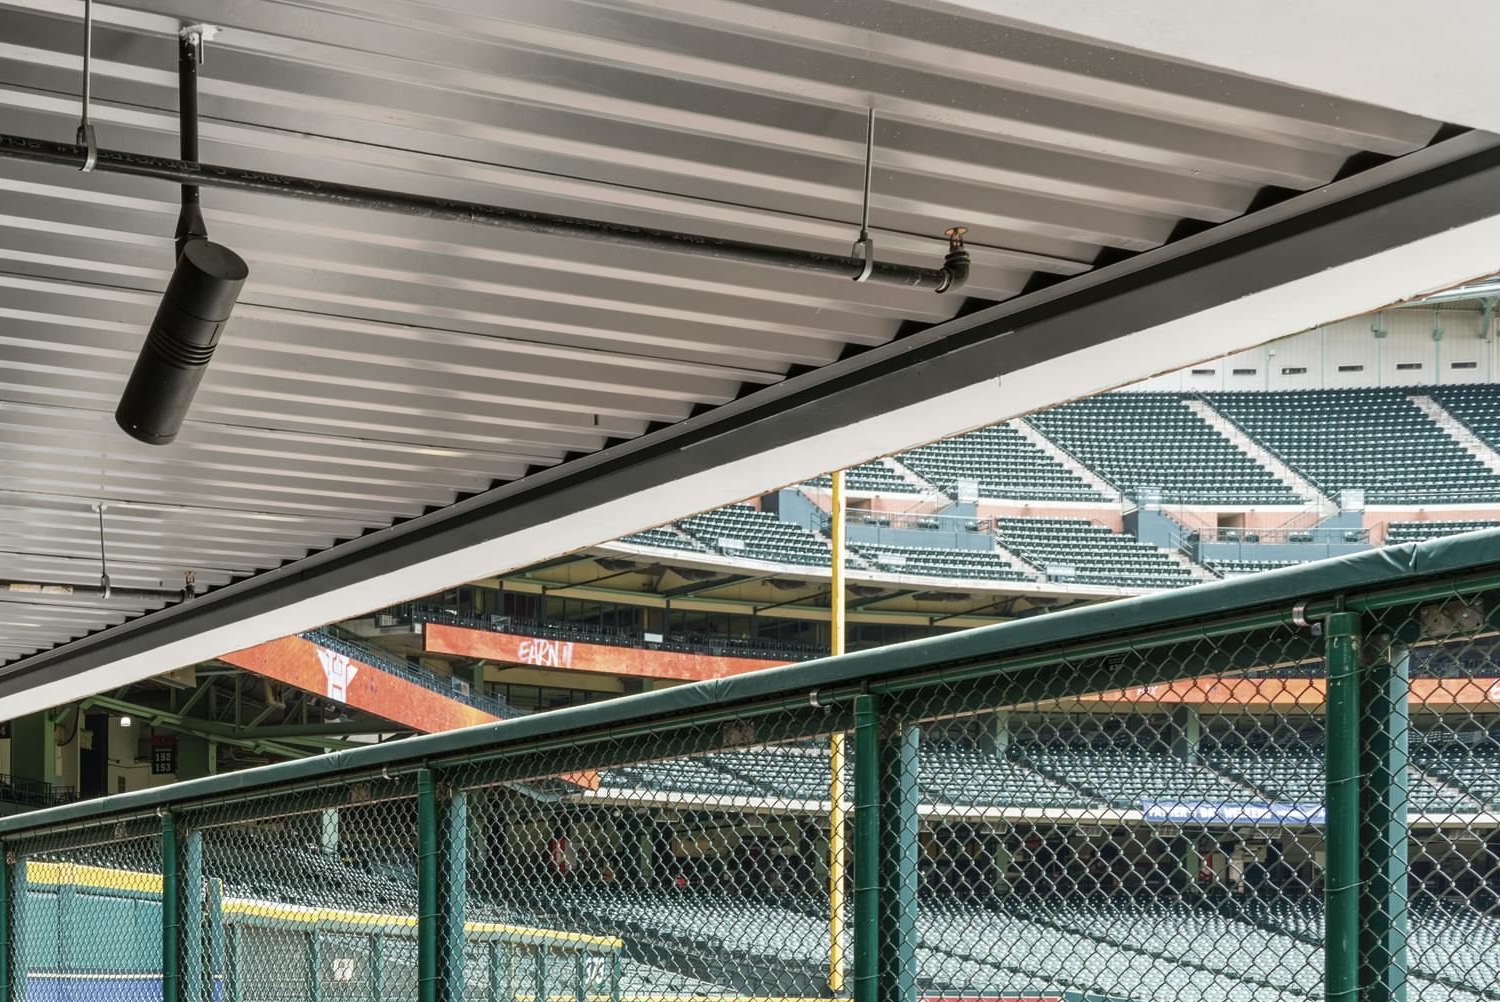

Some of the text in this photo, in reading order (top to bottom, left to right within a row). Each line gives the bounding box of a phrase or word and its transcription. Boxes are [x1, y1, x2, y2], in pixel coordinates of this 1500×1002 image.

[518, 637, 559, 667] EARN
[155, 753, 172, 762] 152
[155, 763, 172, 772] 153
